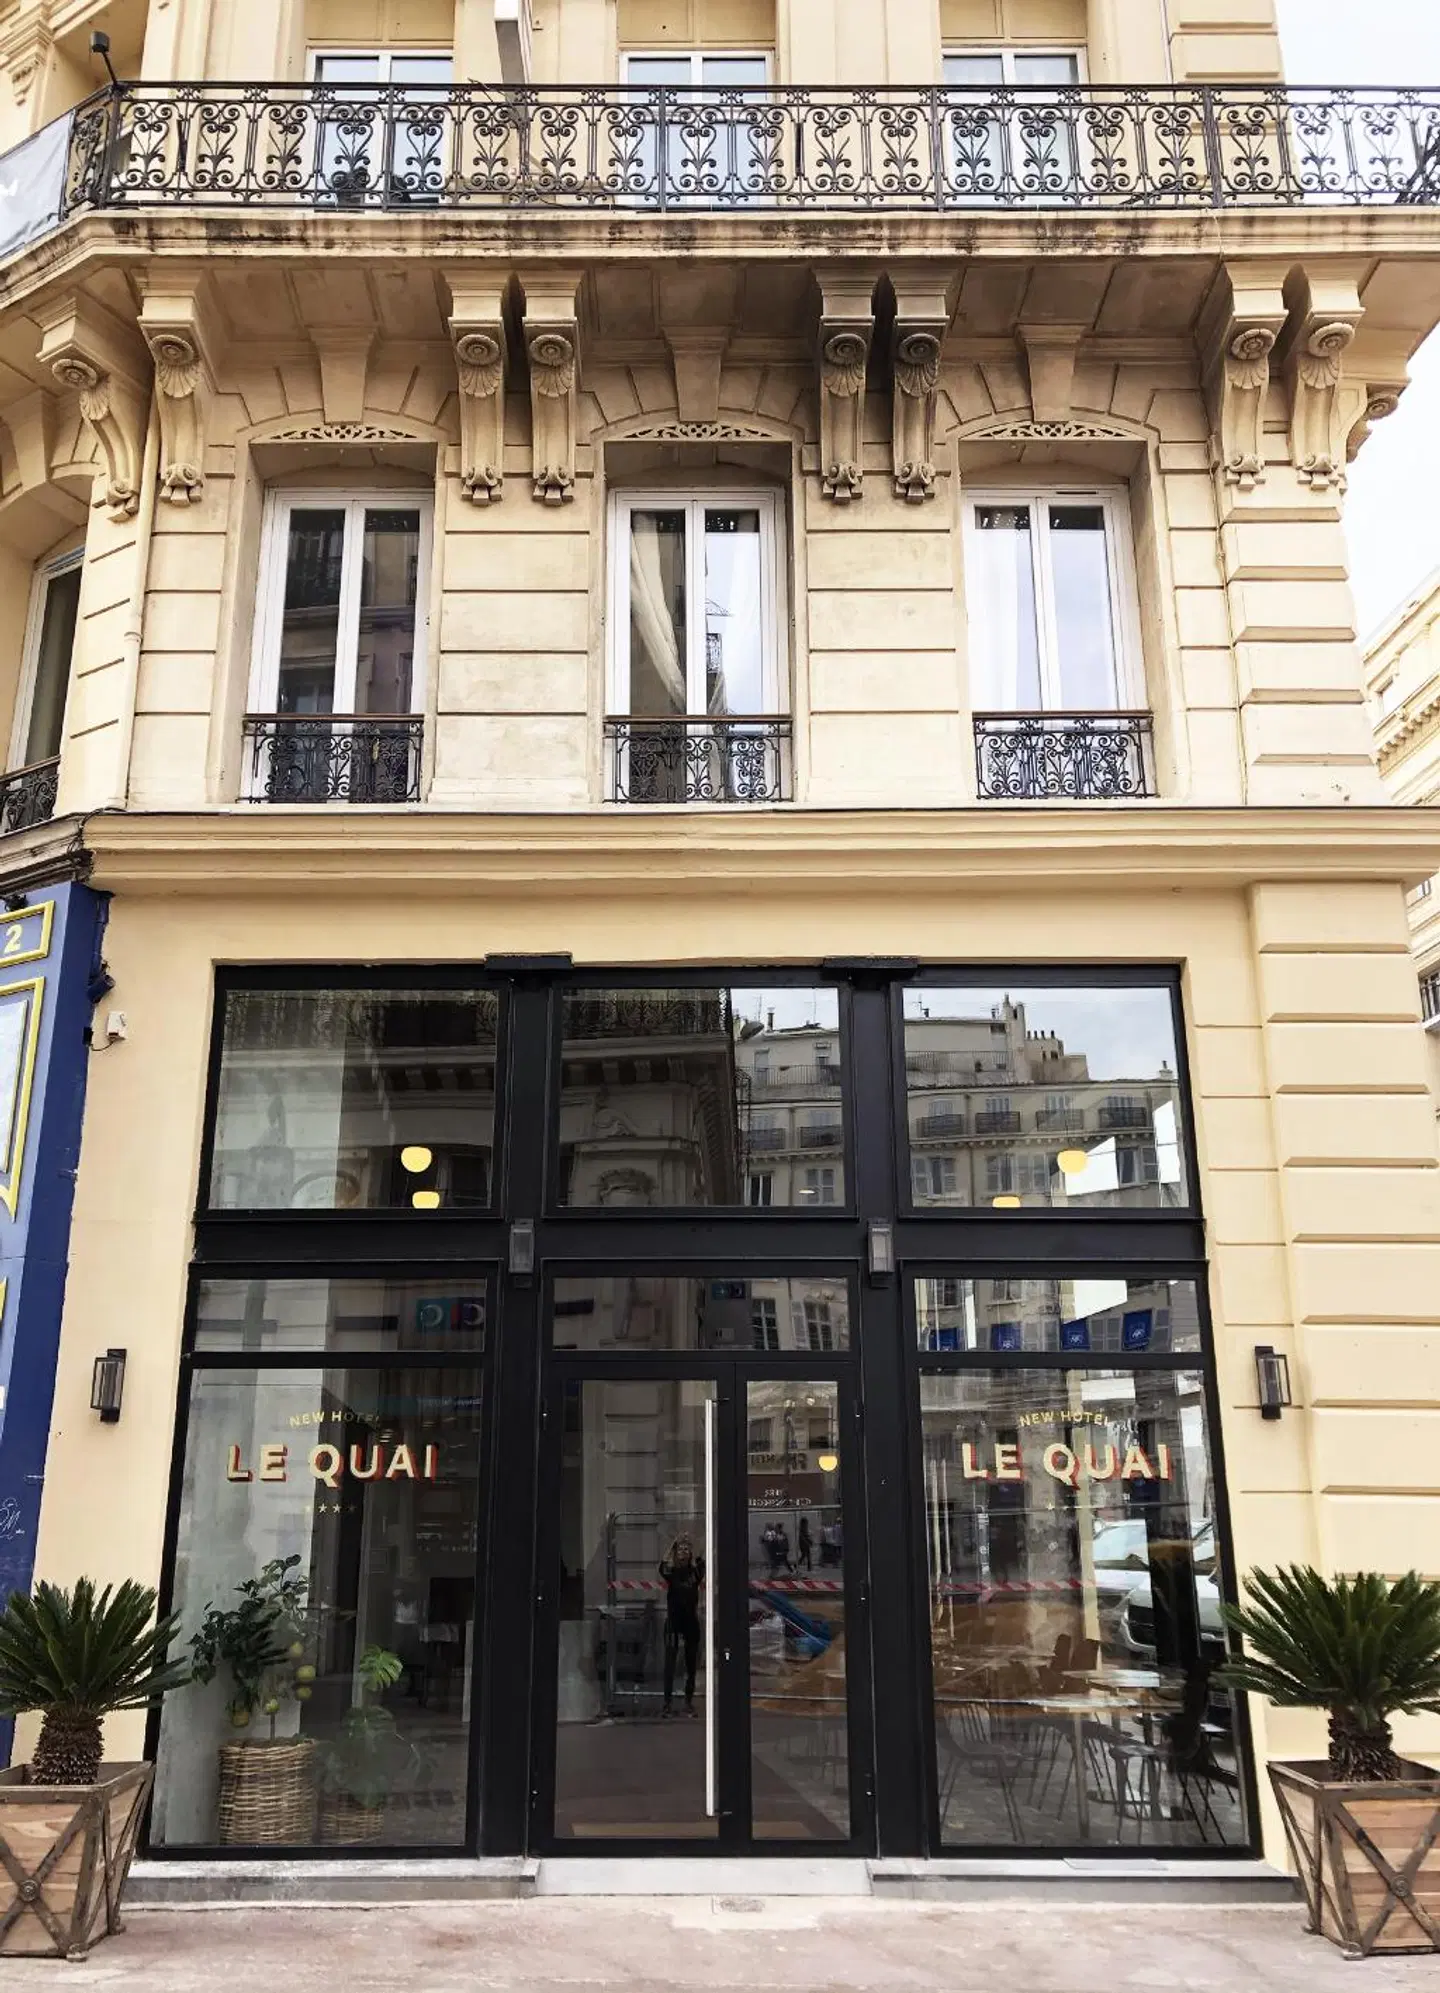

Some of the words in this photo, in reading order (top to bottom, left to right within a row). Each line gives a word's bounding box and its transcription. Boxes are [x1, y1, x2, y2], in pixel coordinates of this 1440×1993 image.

[4, 924, 22, 954] 2
[289, 1410, 325, 1428] NEW
[1020, 1411, 1054, 1427] NEW
[1061, 1411, 1109, 1426] HOTEL
[227, 1444, 287, 1481] LE
[308, 1443, 440, 1488] QUAI
[961, 1443, 1024, 1480] LE
[1043, 1443, 1172, 1489] QUAI
